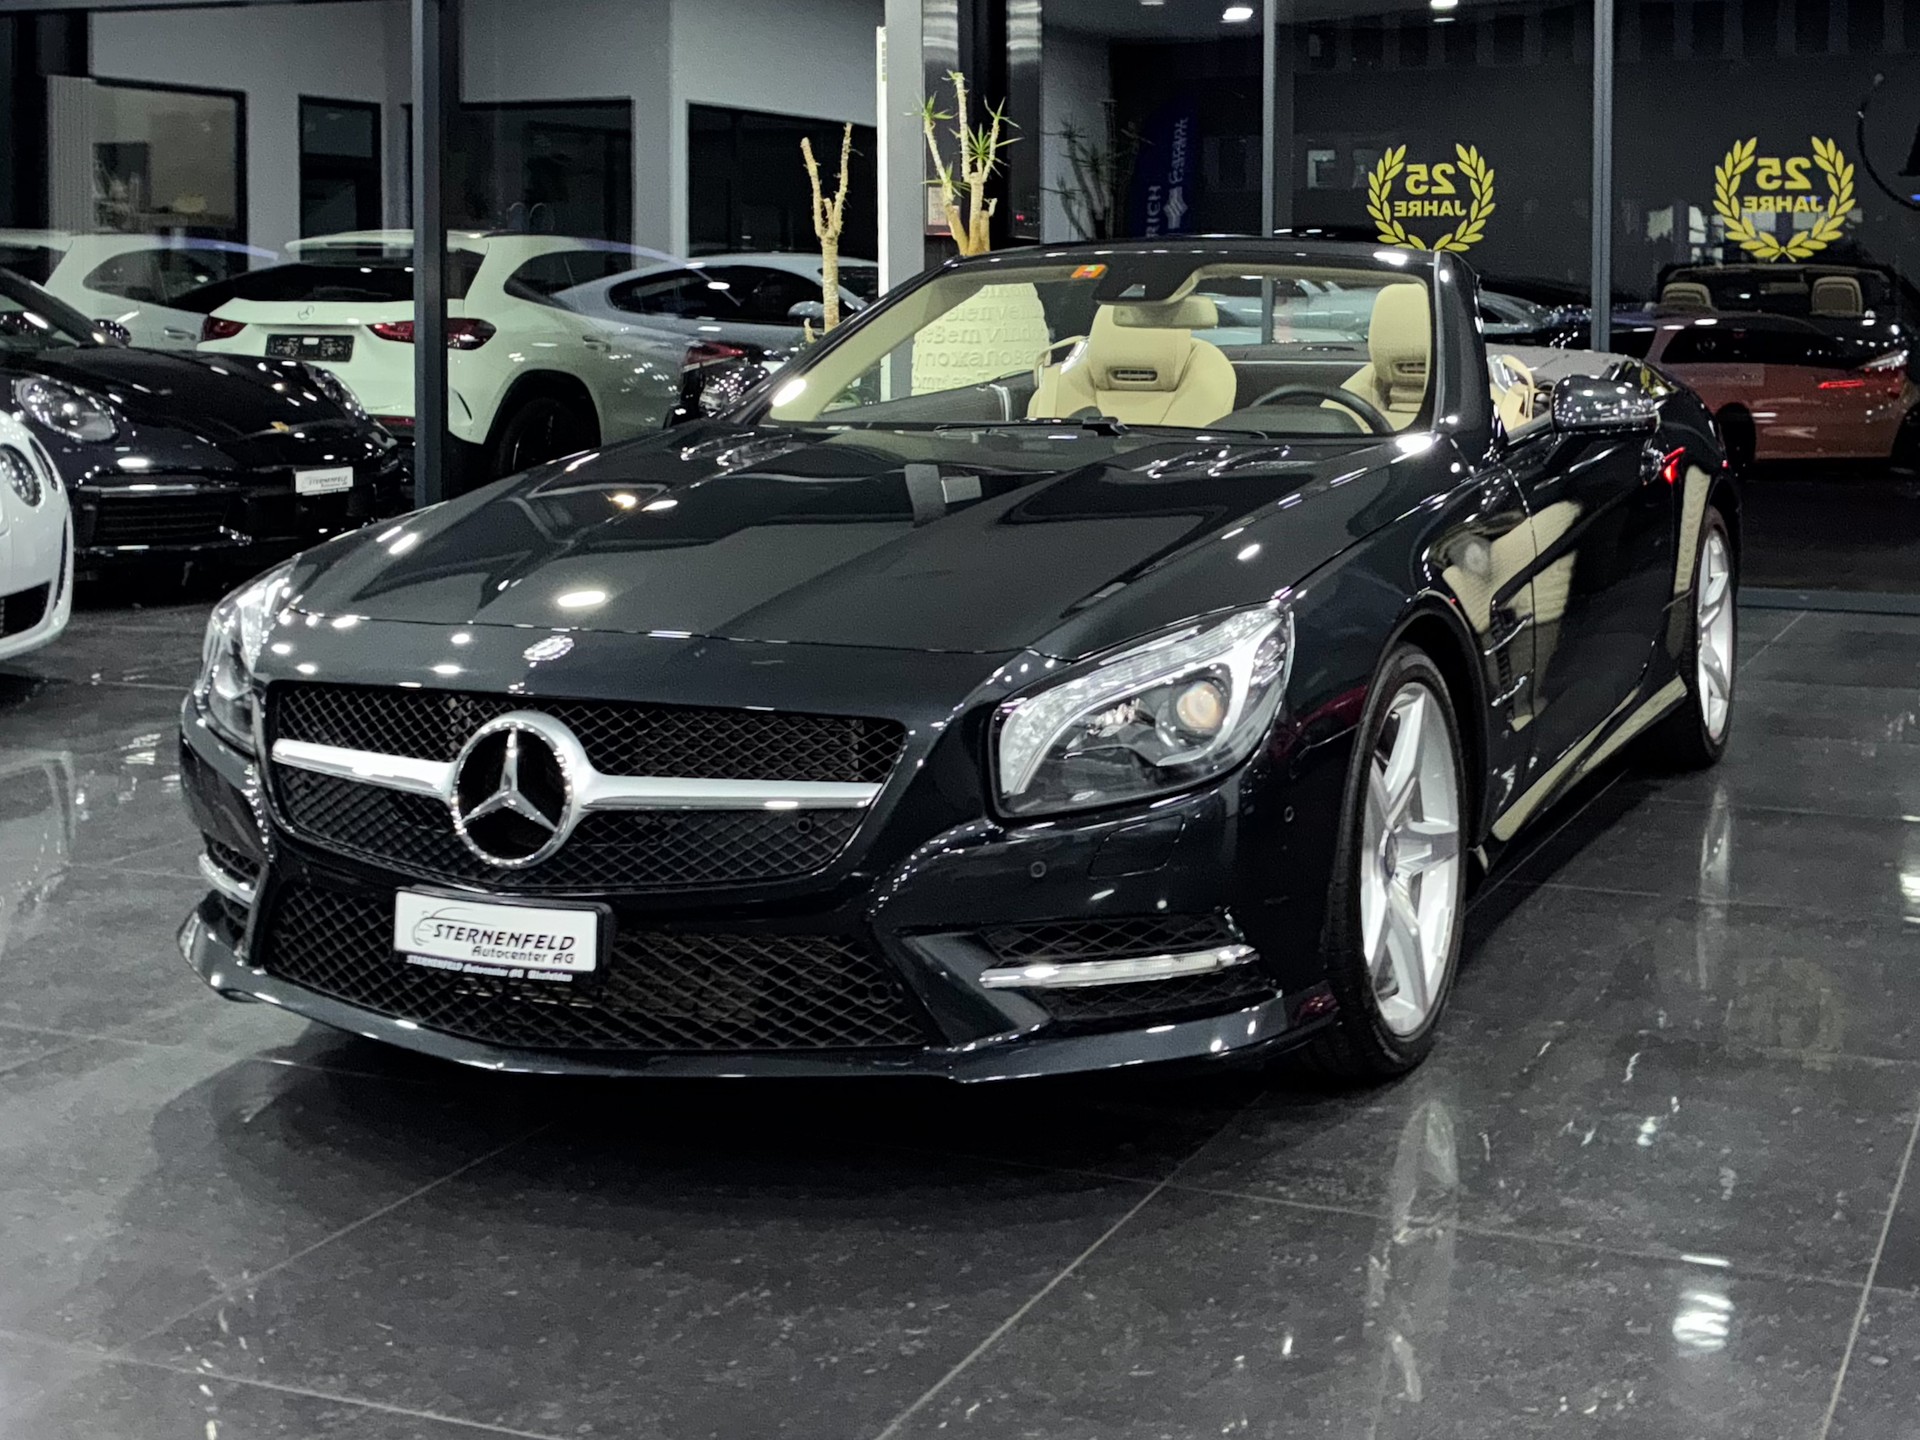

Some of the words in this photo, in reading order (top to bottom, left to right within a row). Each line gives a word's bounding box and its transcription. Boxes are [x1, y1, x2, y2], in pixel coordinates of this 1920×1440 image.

[434, 924, 575, 951] STERNENFELD
[472, 945, 548, 964] Autocenter
[552, 952, 575, 965] AG
